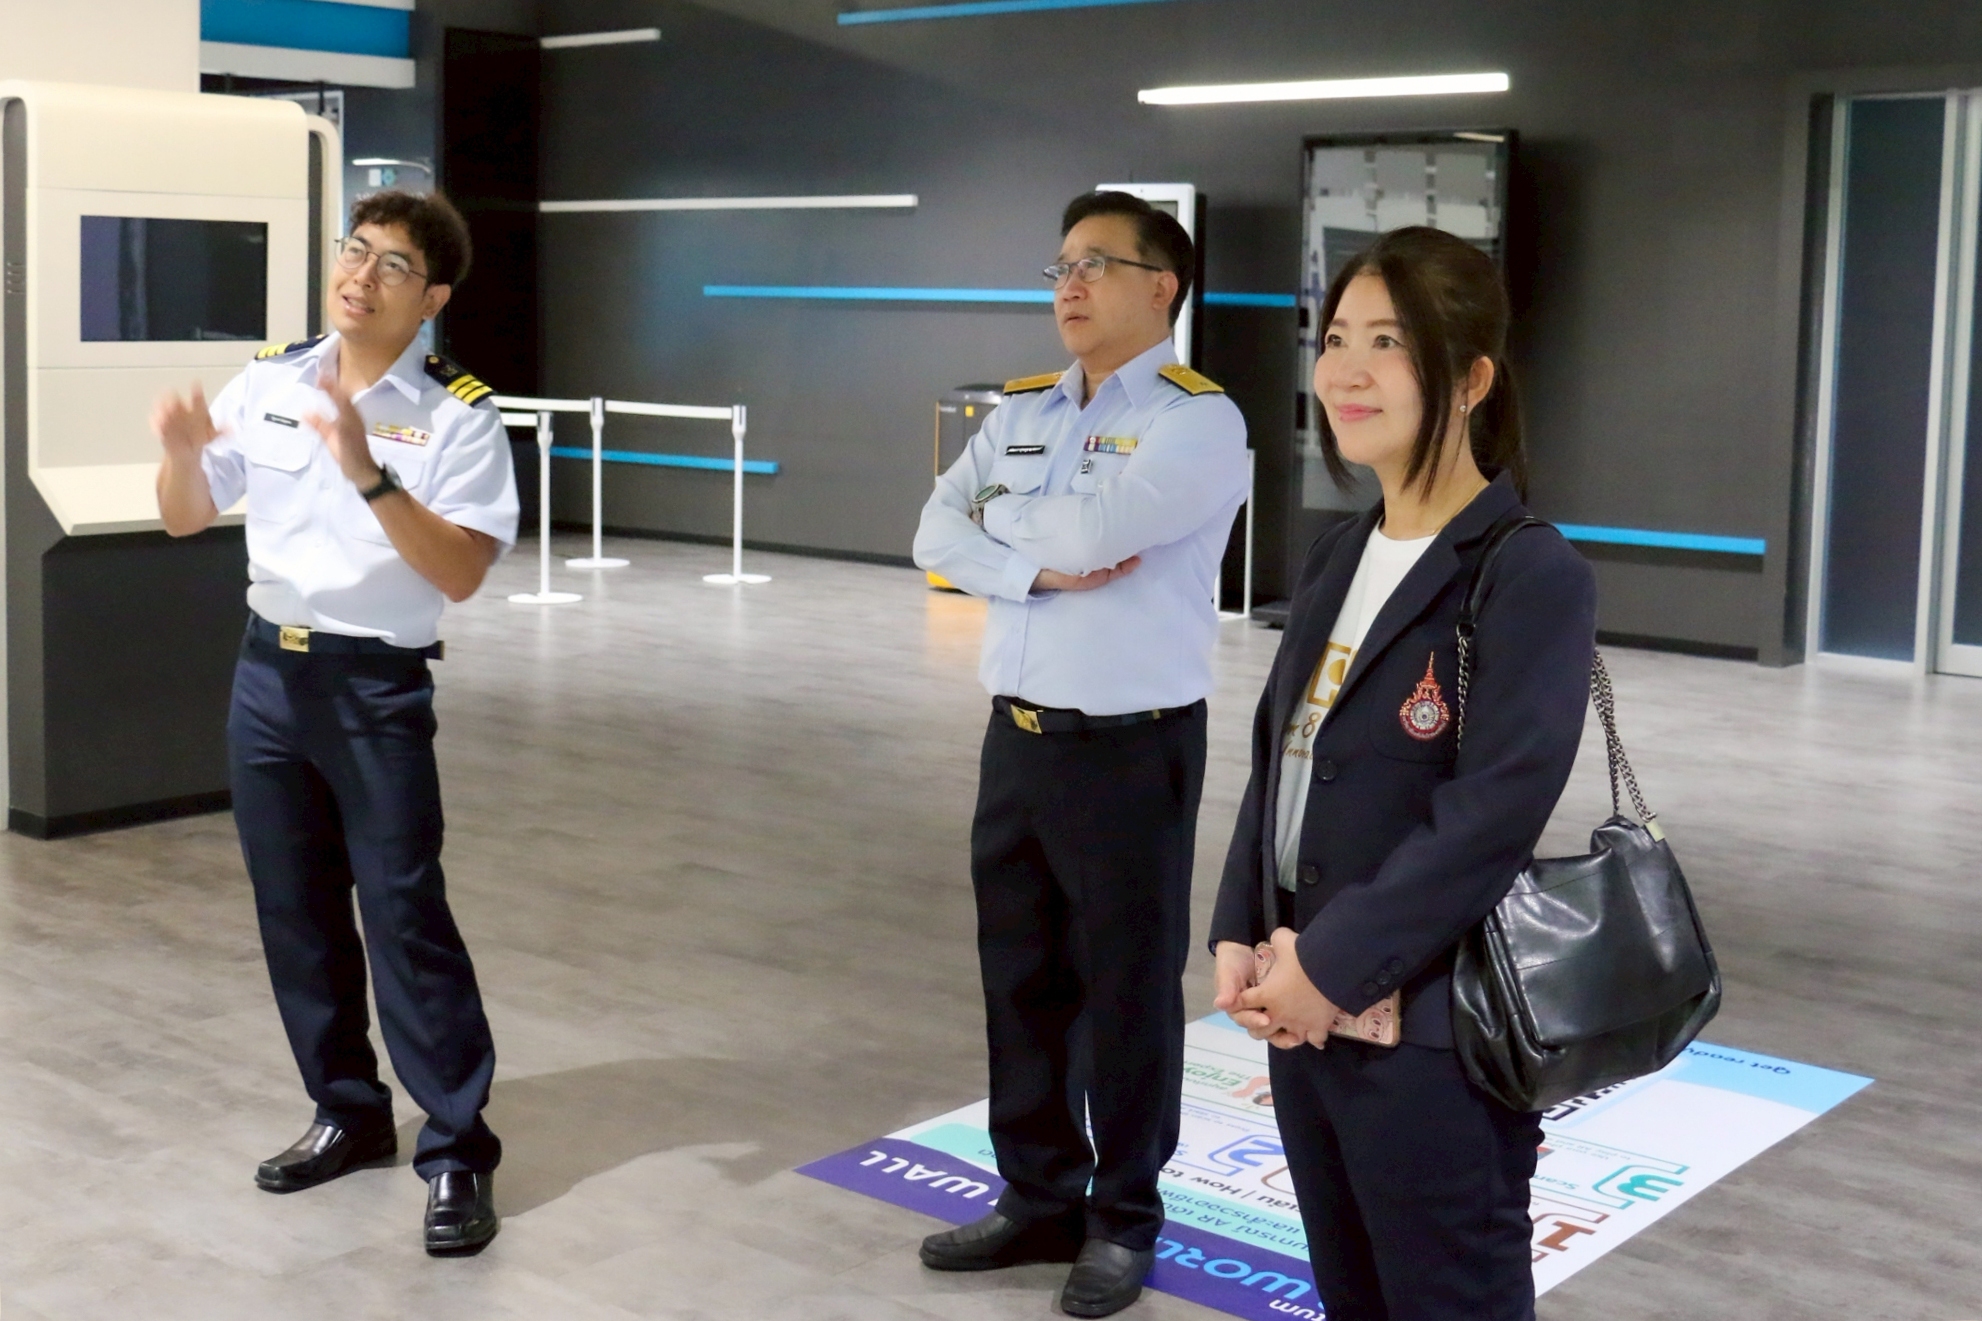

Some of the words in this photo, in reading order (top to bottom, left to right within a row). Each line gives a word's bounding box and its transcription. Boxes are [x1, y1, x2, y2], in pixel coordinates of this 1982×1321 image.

[1183, 1066, 1242, 1087] Enjoy
[1228, 1139, 1285, 1167] 2
[859, 1150, 990, 1199] WALL
[1190, 1177, 1243, 1195] How
[1617, 1174, 1685, 1202] 3
[1197, 1214, 1232, 1227] AR
[1536, 1220, 1597, 1252] 1
[1155, 1236, 1312, 1300] WORL
[1269, 1299, 1327, 1321] tum
